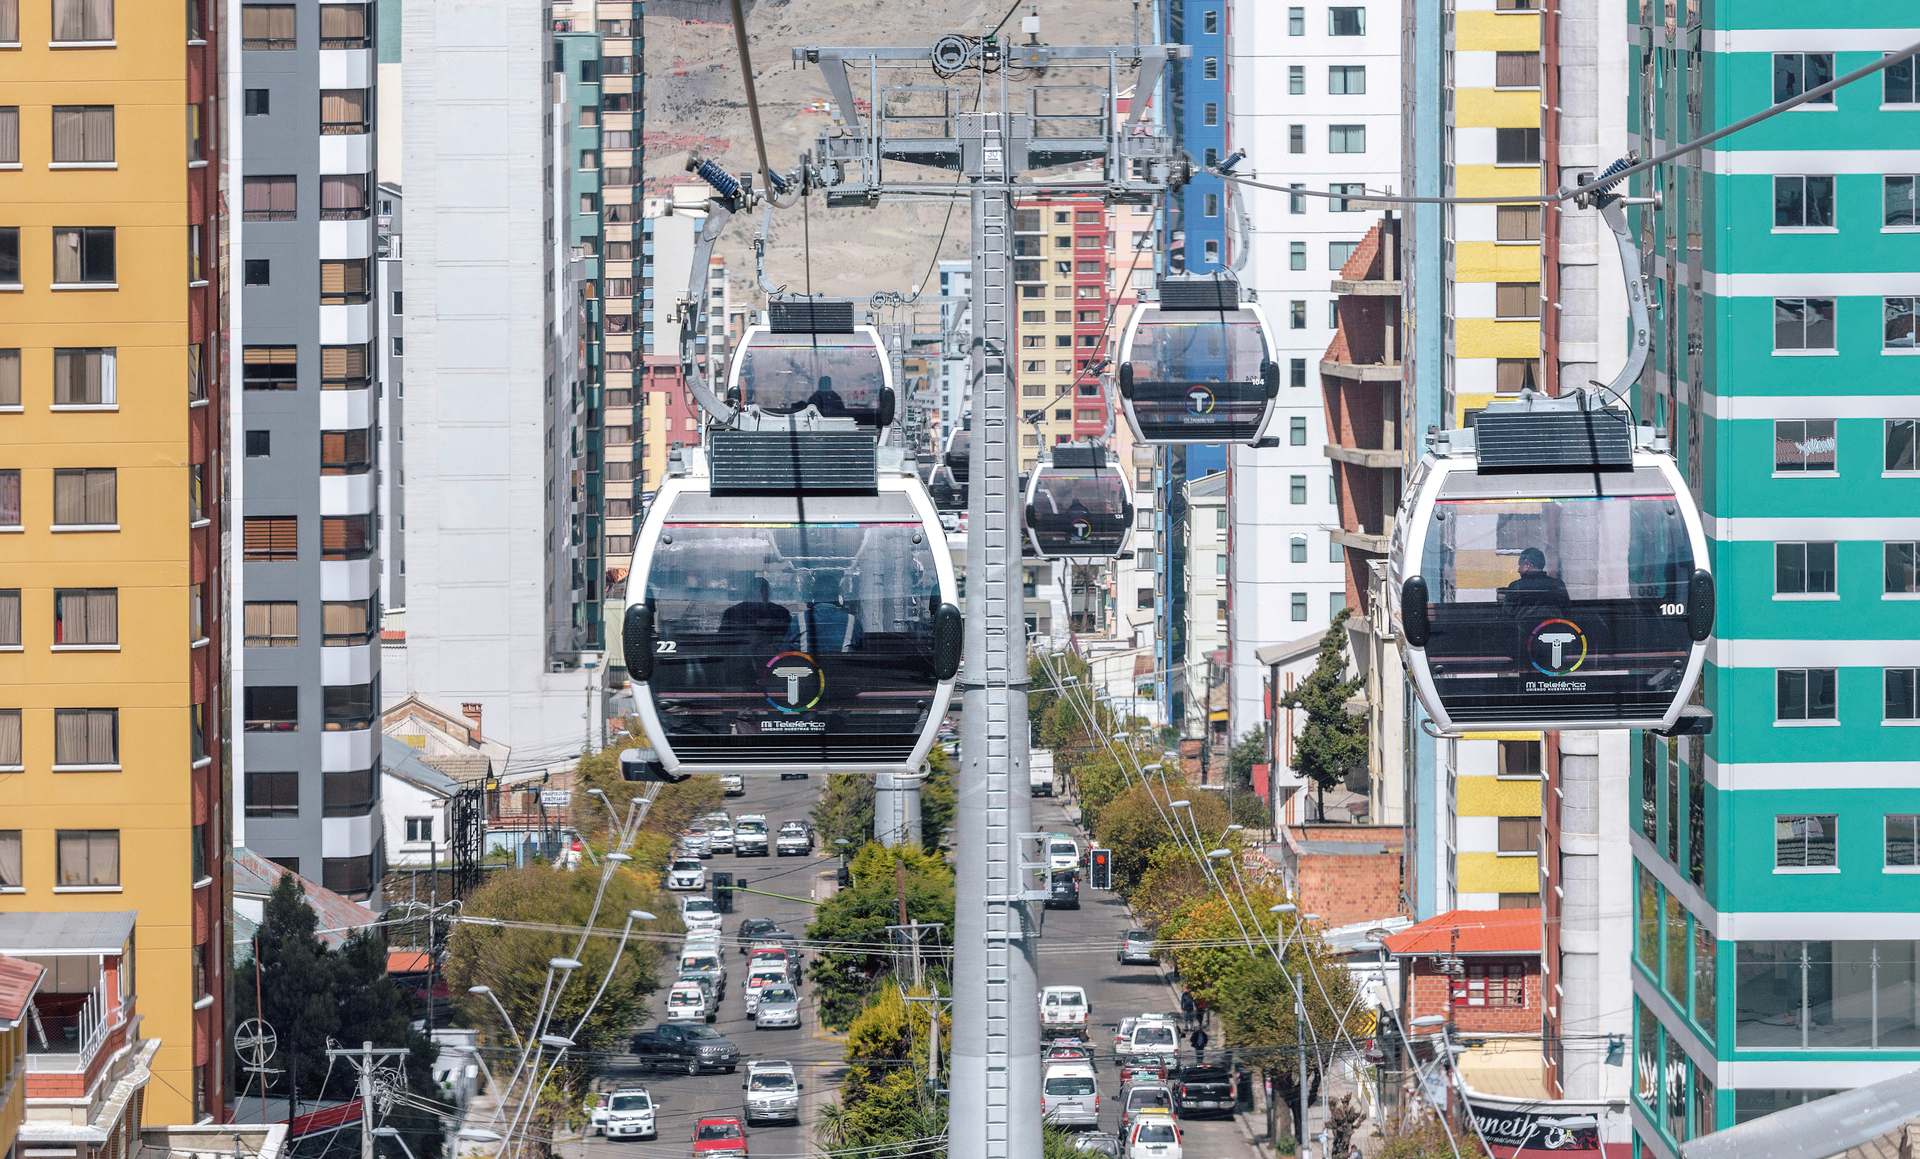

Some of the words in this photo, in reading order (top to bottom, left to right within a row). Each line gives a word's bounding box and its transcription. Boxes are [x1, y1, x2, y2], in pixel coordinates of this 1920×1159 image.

[987, 150, 998, 158] 30
[1252, 378, 1265, 386] 104
[1659, 603, 1685, 616] 100
[656, 640, 677, 654] 22
[1537, 680, 1587, 688] Teleférico
[760, 720, 772, 728] Mi
[773, 720, 826, 728] Teleférico
